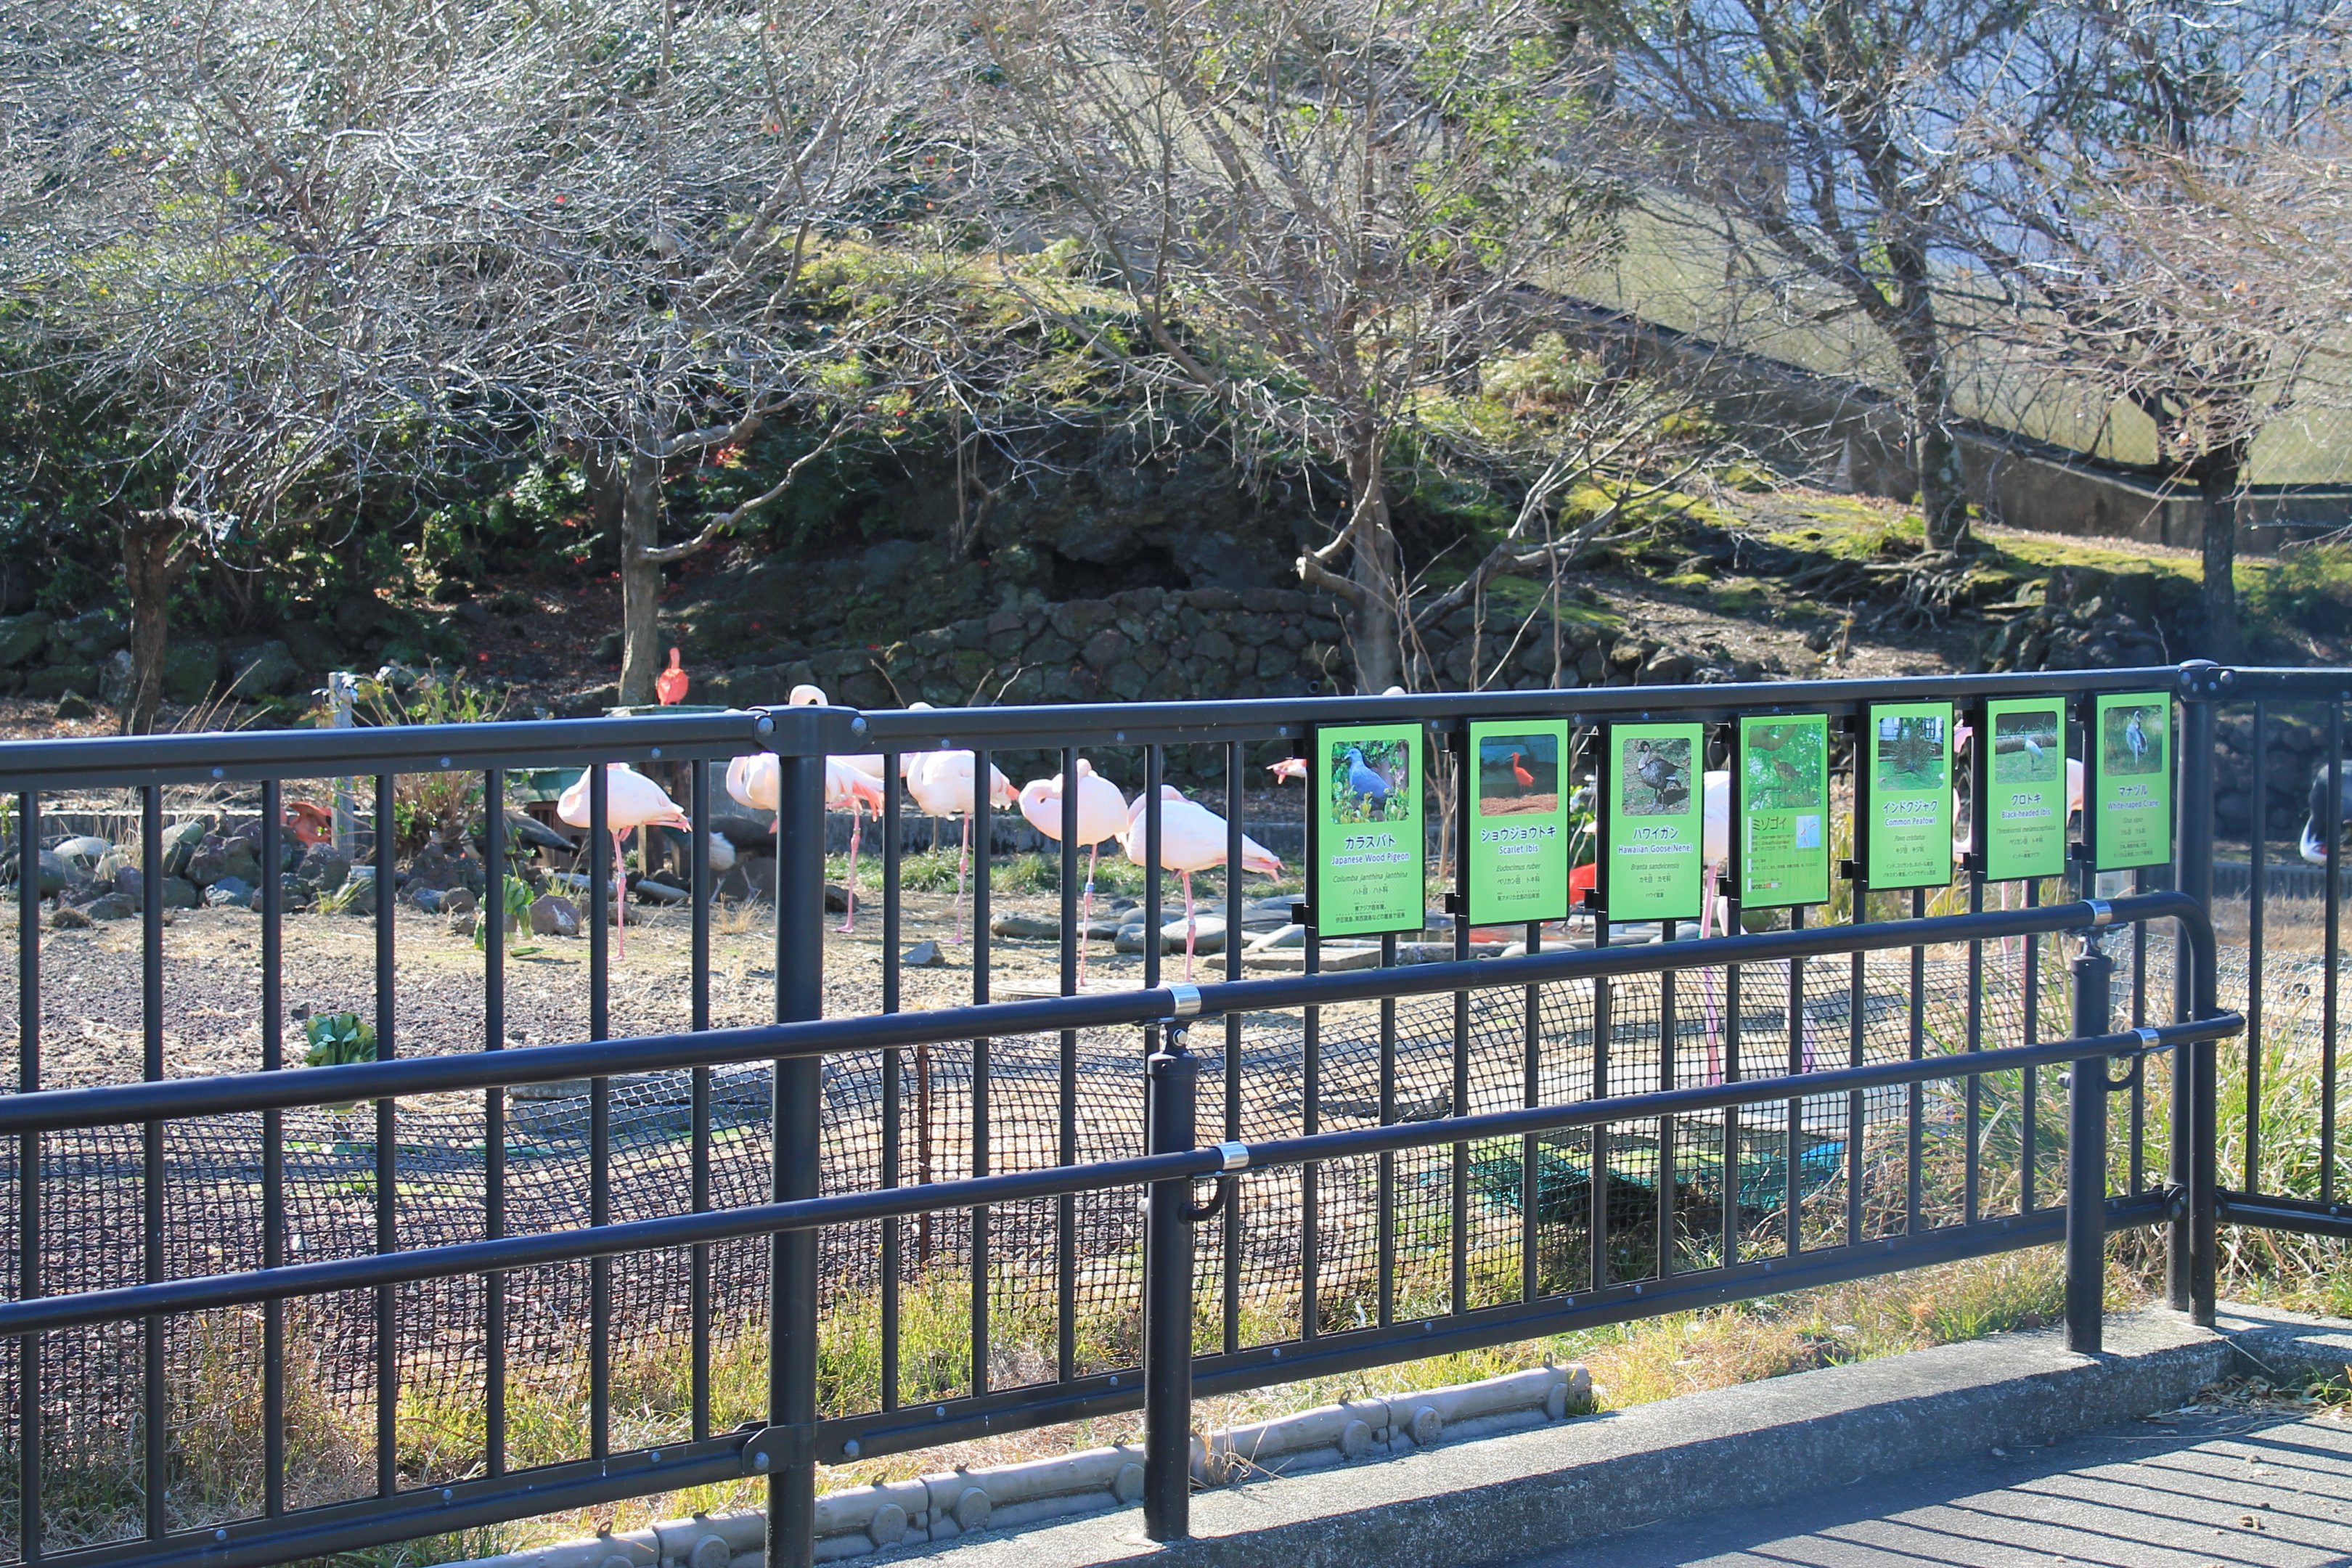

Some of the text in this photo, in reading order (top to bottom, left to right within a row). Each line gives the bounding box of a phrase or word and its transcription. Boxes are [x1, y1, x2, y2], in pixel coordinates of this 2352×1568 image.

[2119, 785, 2148, 796] マナヅル
[2012, 793, 2041, 806] クロトキ
[2108, 801, 2142, 809] White-naped
[1883, 801, 1937, 814] インドクジャク
[2001, 809, 2039, 819] Black-headed
[1752, 817, 1787, 831] ミゾゴイ
[1482, 825, 1556, 842] ショウジョウトキ
[1633, 826, 1678, 840] ハワイガン
[1345, 834, 1395, 850] カラスバト
[1499, 844, 1538, 854] Scarlet Ibis
[1619, 844, 1692, 854] Hawaiian Goose(Nene)
[1331, 852, 1409, 866] Japanese Wood Pigeon
[1333, 875, 1358, 883] Columba
